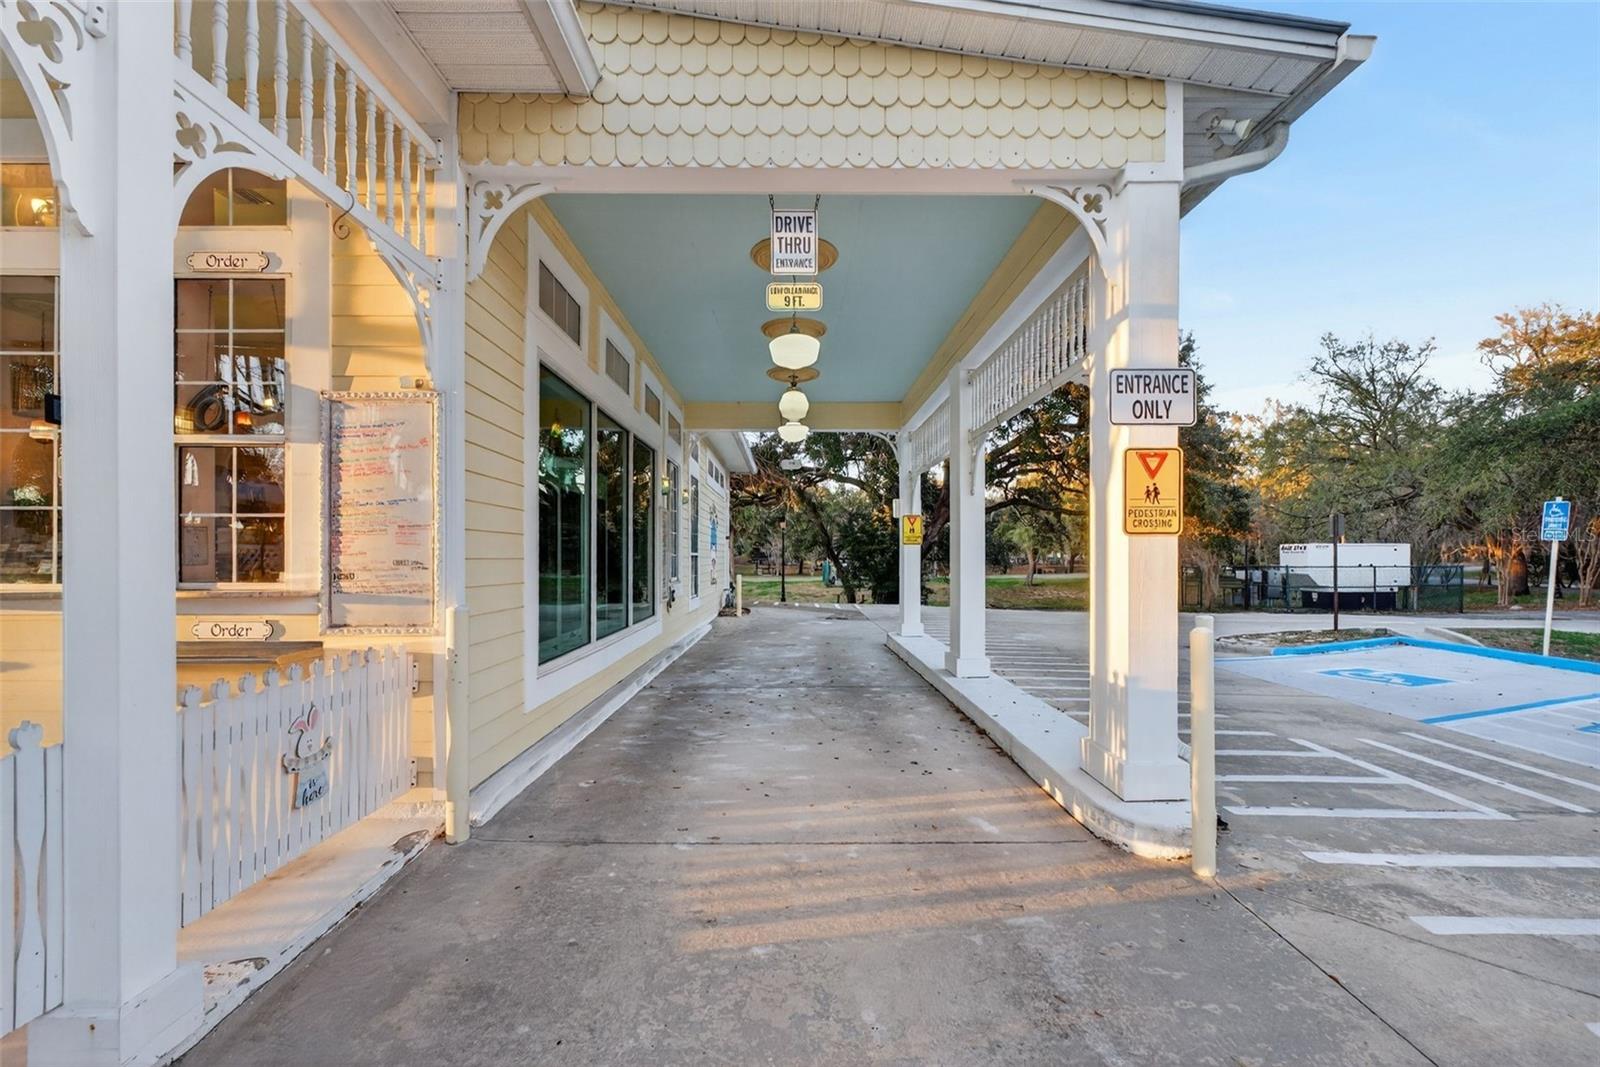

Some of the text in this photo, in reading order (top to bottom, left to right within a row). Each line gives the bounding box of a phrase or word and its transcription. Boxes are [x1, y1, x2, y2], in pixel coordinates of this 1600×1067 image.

[775, 216, 813, 233] DRIVE
[777, 237, 811, 254] THRU
[206, 254, 248, 268] Order
[776, 258, 813, 268] ENTRANCE
[784, 295, 805, 307] 9 FT.
[1116, 374, 1189, 394] ENTRANCE
[1132, 399, 1172, 419] ONLY
[1128, 509, 1177, 518] PEDESTRIAN
[1132, 518, 1173, 528] CROSSING
[211, 623, 252, 637] Order
[302, 786, 324, 806] here
